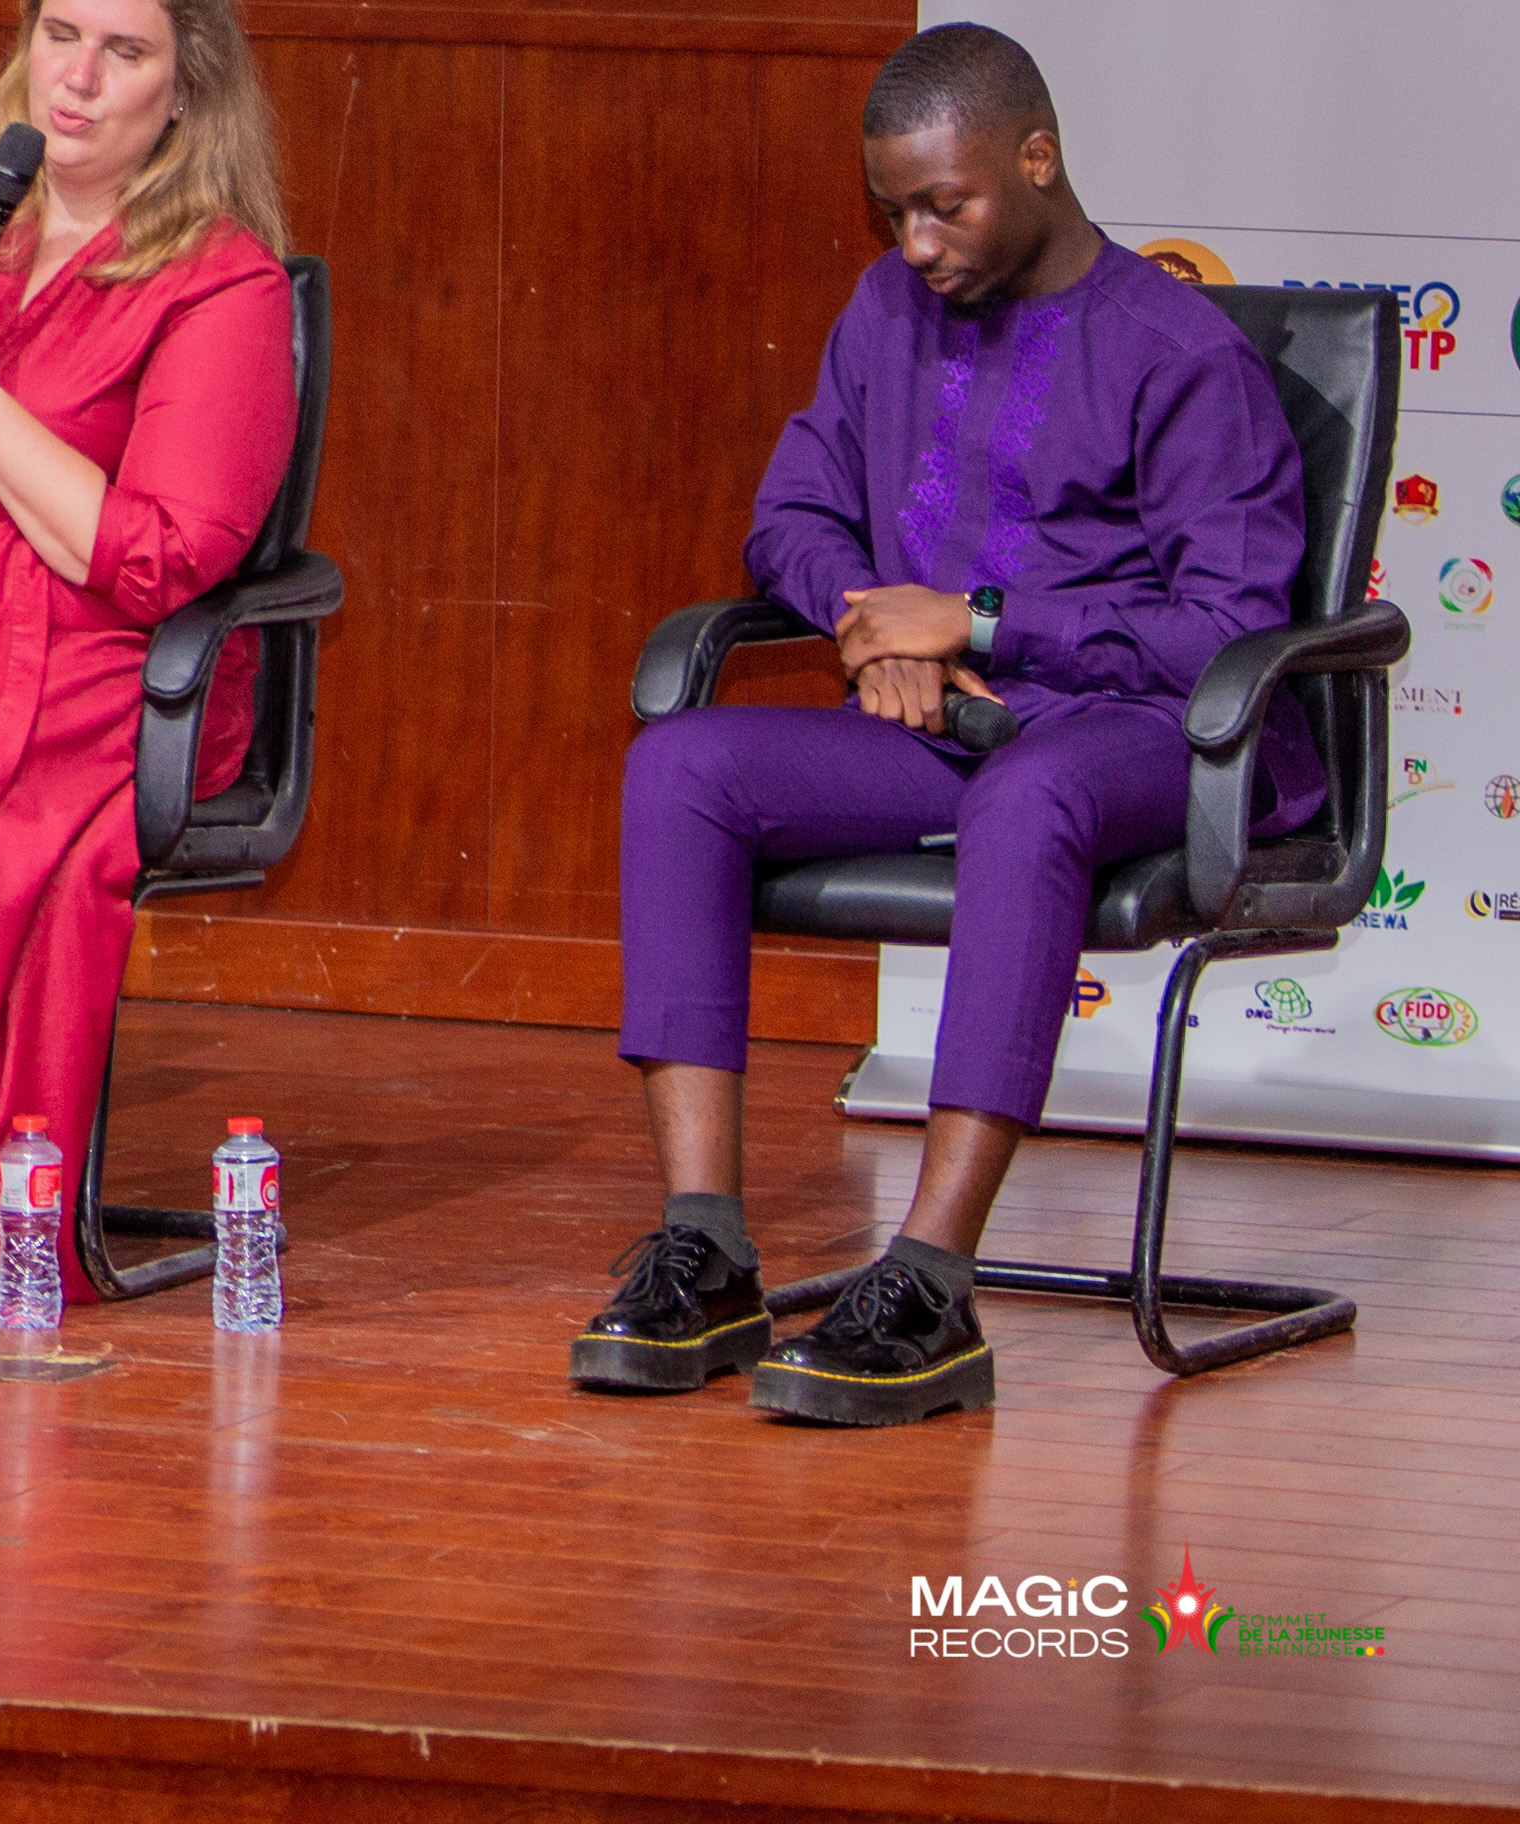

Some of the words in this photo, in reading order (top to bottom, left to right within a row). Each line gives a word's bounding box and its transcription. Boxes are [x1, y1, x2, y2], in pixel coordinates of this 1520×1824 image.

[1405, 328, 1455, 370] TP
[1351, 911, 1409, 931] REWA
[1405, 1000, 1451, 1020] FIDD
